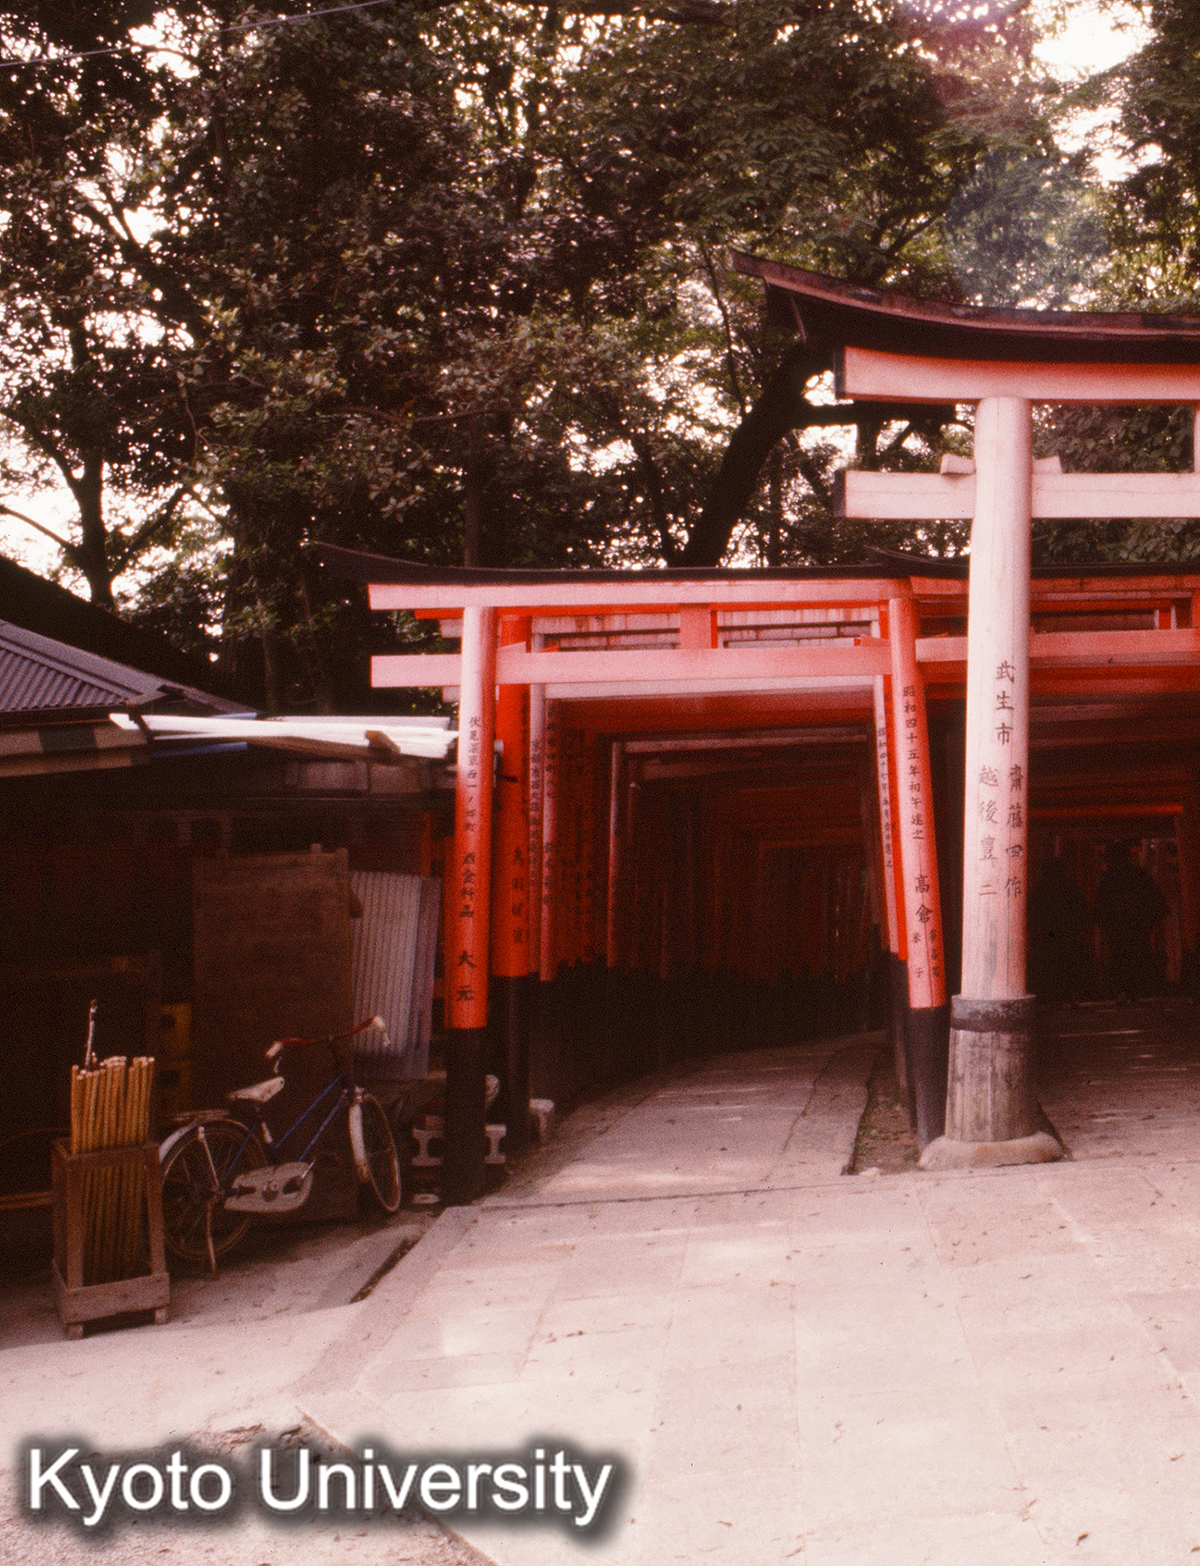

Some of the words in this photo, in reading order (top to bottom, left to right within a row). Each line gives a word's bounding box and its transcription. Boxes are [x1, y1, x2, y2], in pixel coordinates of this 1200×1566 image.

[995, 660, 1016, 747] 武生市
[902, 685, 925, 841] 昭和四十五年初午建之
[456, 950, 476, 1002] 大元
